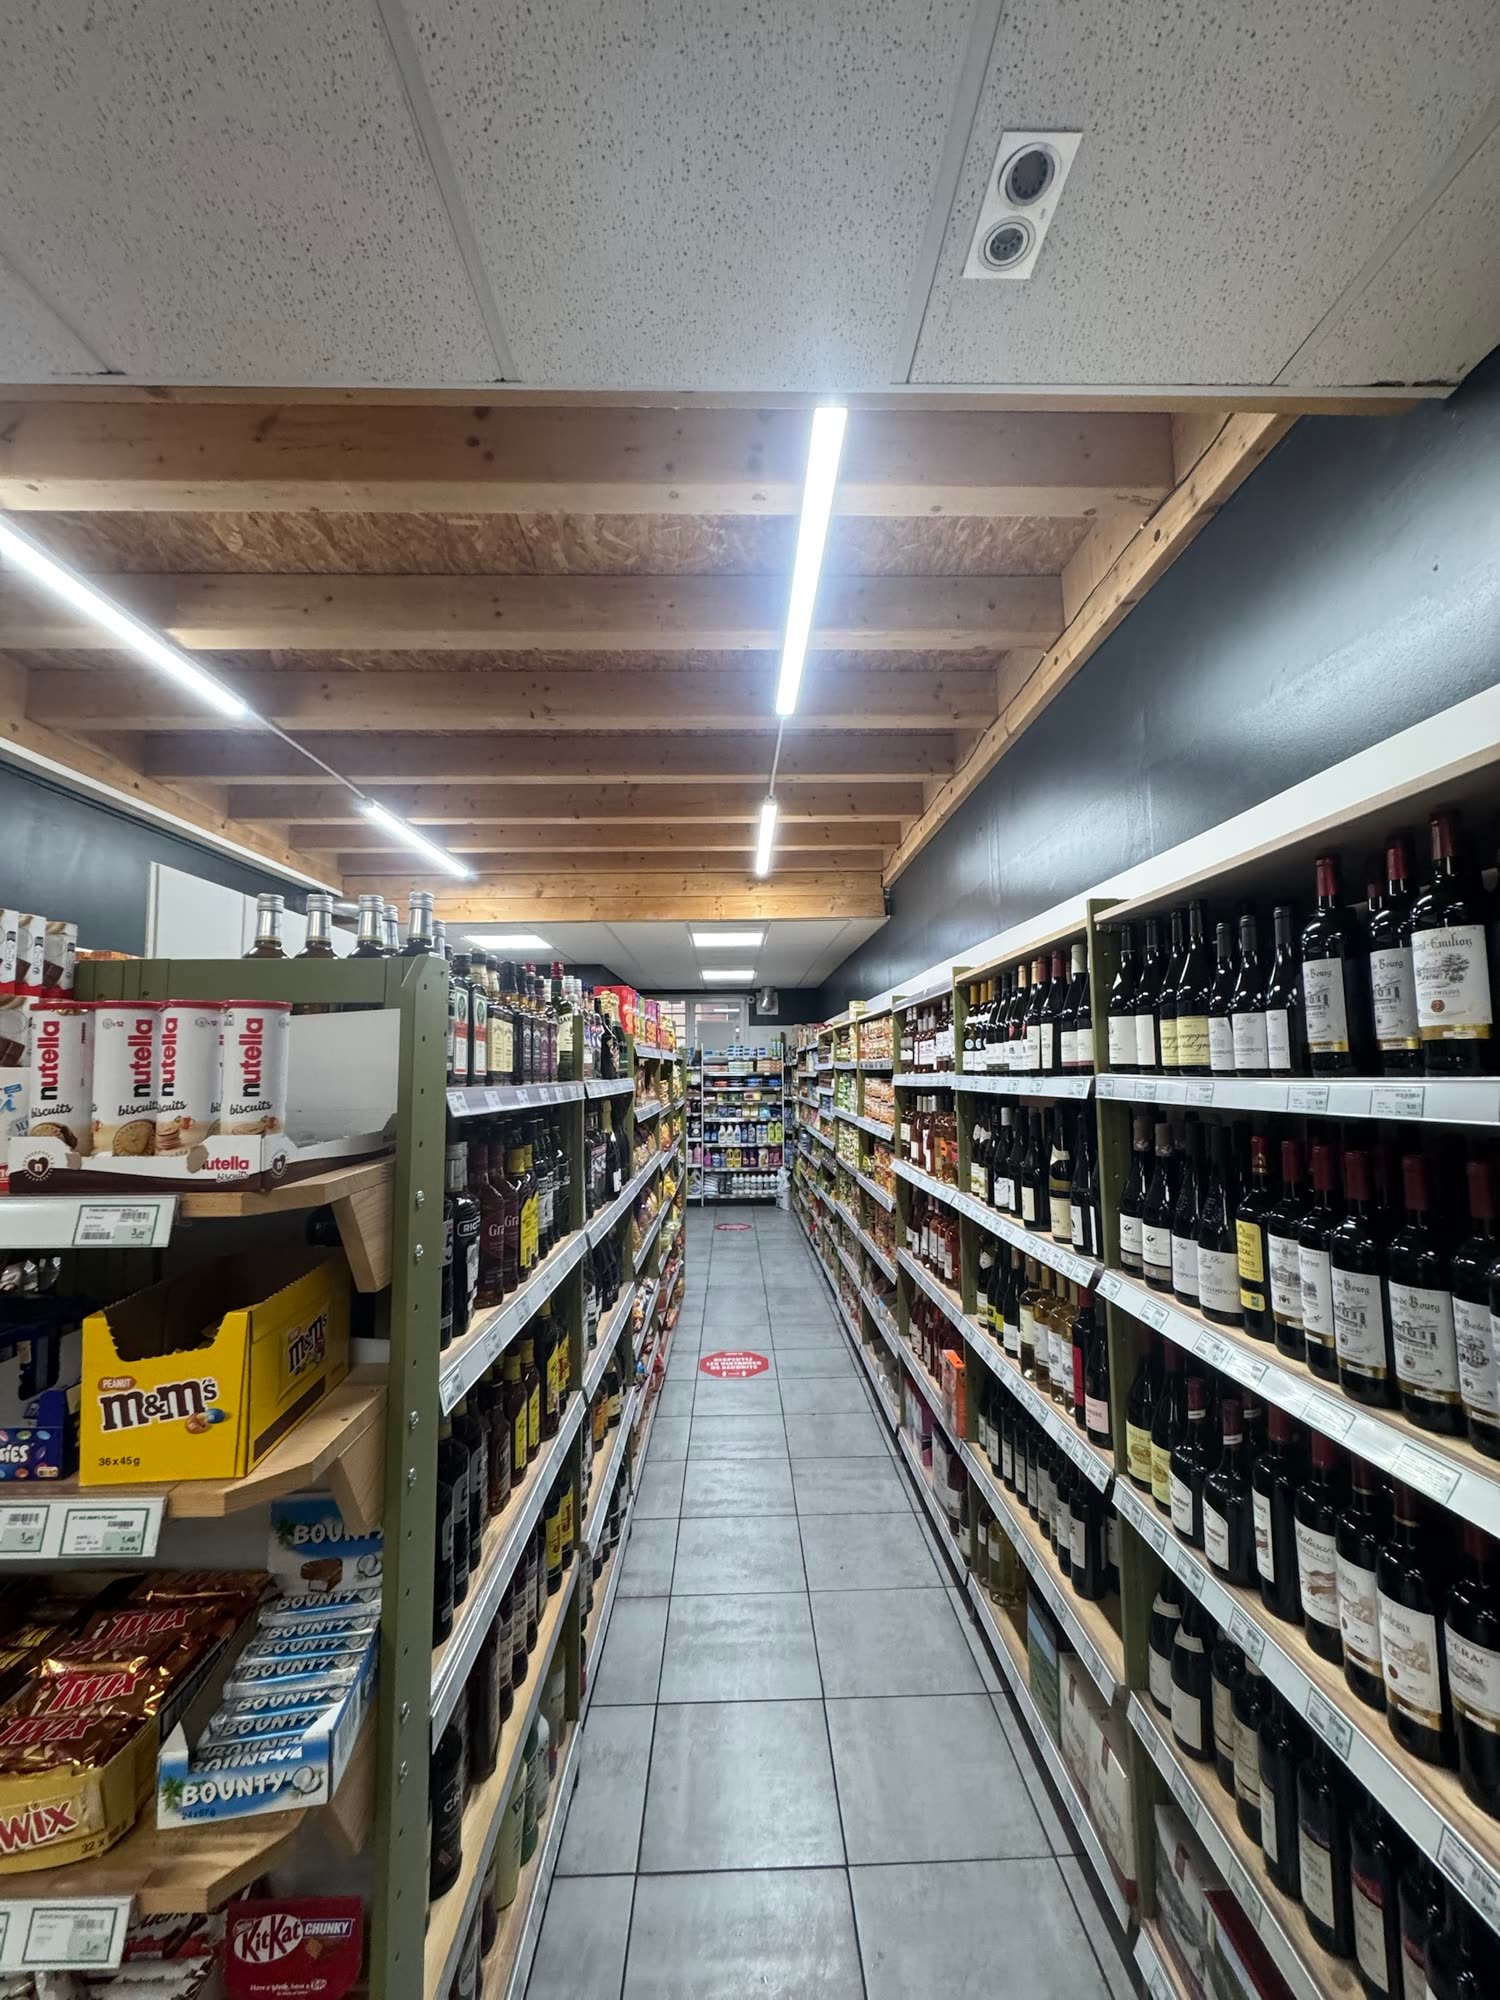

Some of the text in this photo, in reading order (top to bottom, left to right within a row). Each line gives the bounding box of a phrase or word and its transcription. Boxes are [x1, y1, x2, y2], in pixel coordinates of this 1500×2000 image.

[37, 1020, 60, 1101] nutella
[127, 1018, 153, 1098] nutella
[161, 1017, 178, 1096] nutella
[238, 1017, 263, 1097] nutella
[118, 1101, 158, 1117] biscuit
[229, 1101, 273, 1116] biscuits
[215, 1170, 249, 1183] biscuits
[1409, 1295, 1441, 1313] Bourg
[102, 1378, 132, 1389] PEANUT
[276, 1590, 358, 1611] BOUNTY
[267, 1619, 352, 1640] BOUNTY
[258, 1637, 345, 1656] BOUNTY
[244, 1656, 335, 1680] BOUNTY
[235, 1688, 328, 1713] BOUNTY
[220, 1711, 318, 1737] BOUNTY
[182, 1770, 290, 1808] BOUNTY
[241, 1914, 302, 1962] KitKat
[304, 1921, 350, 1936] CHUNKY
